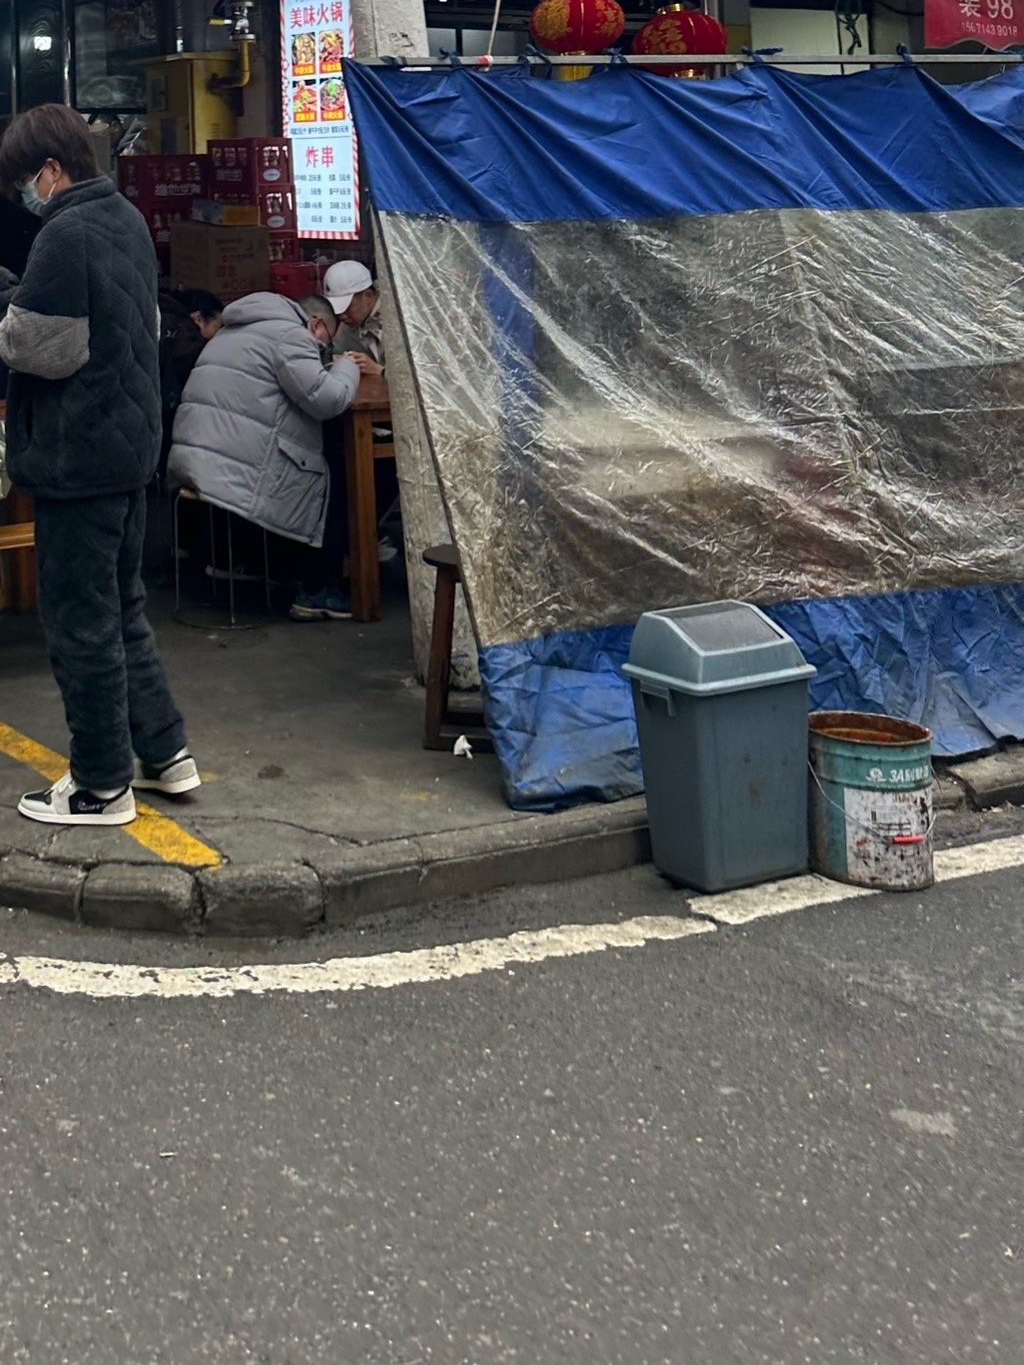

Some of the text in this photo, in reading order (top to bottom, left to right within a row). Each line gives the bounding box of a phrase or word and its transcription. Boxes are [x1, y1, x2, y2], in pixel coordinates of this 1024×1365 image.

[290, 1, 344, 29] 美味火锅
[305, 145, 334, 168] 炸串
